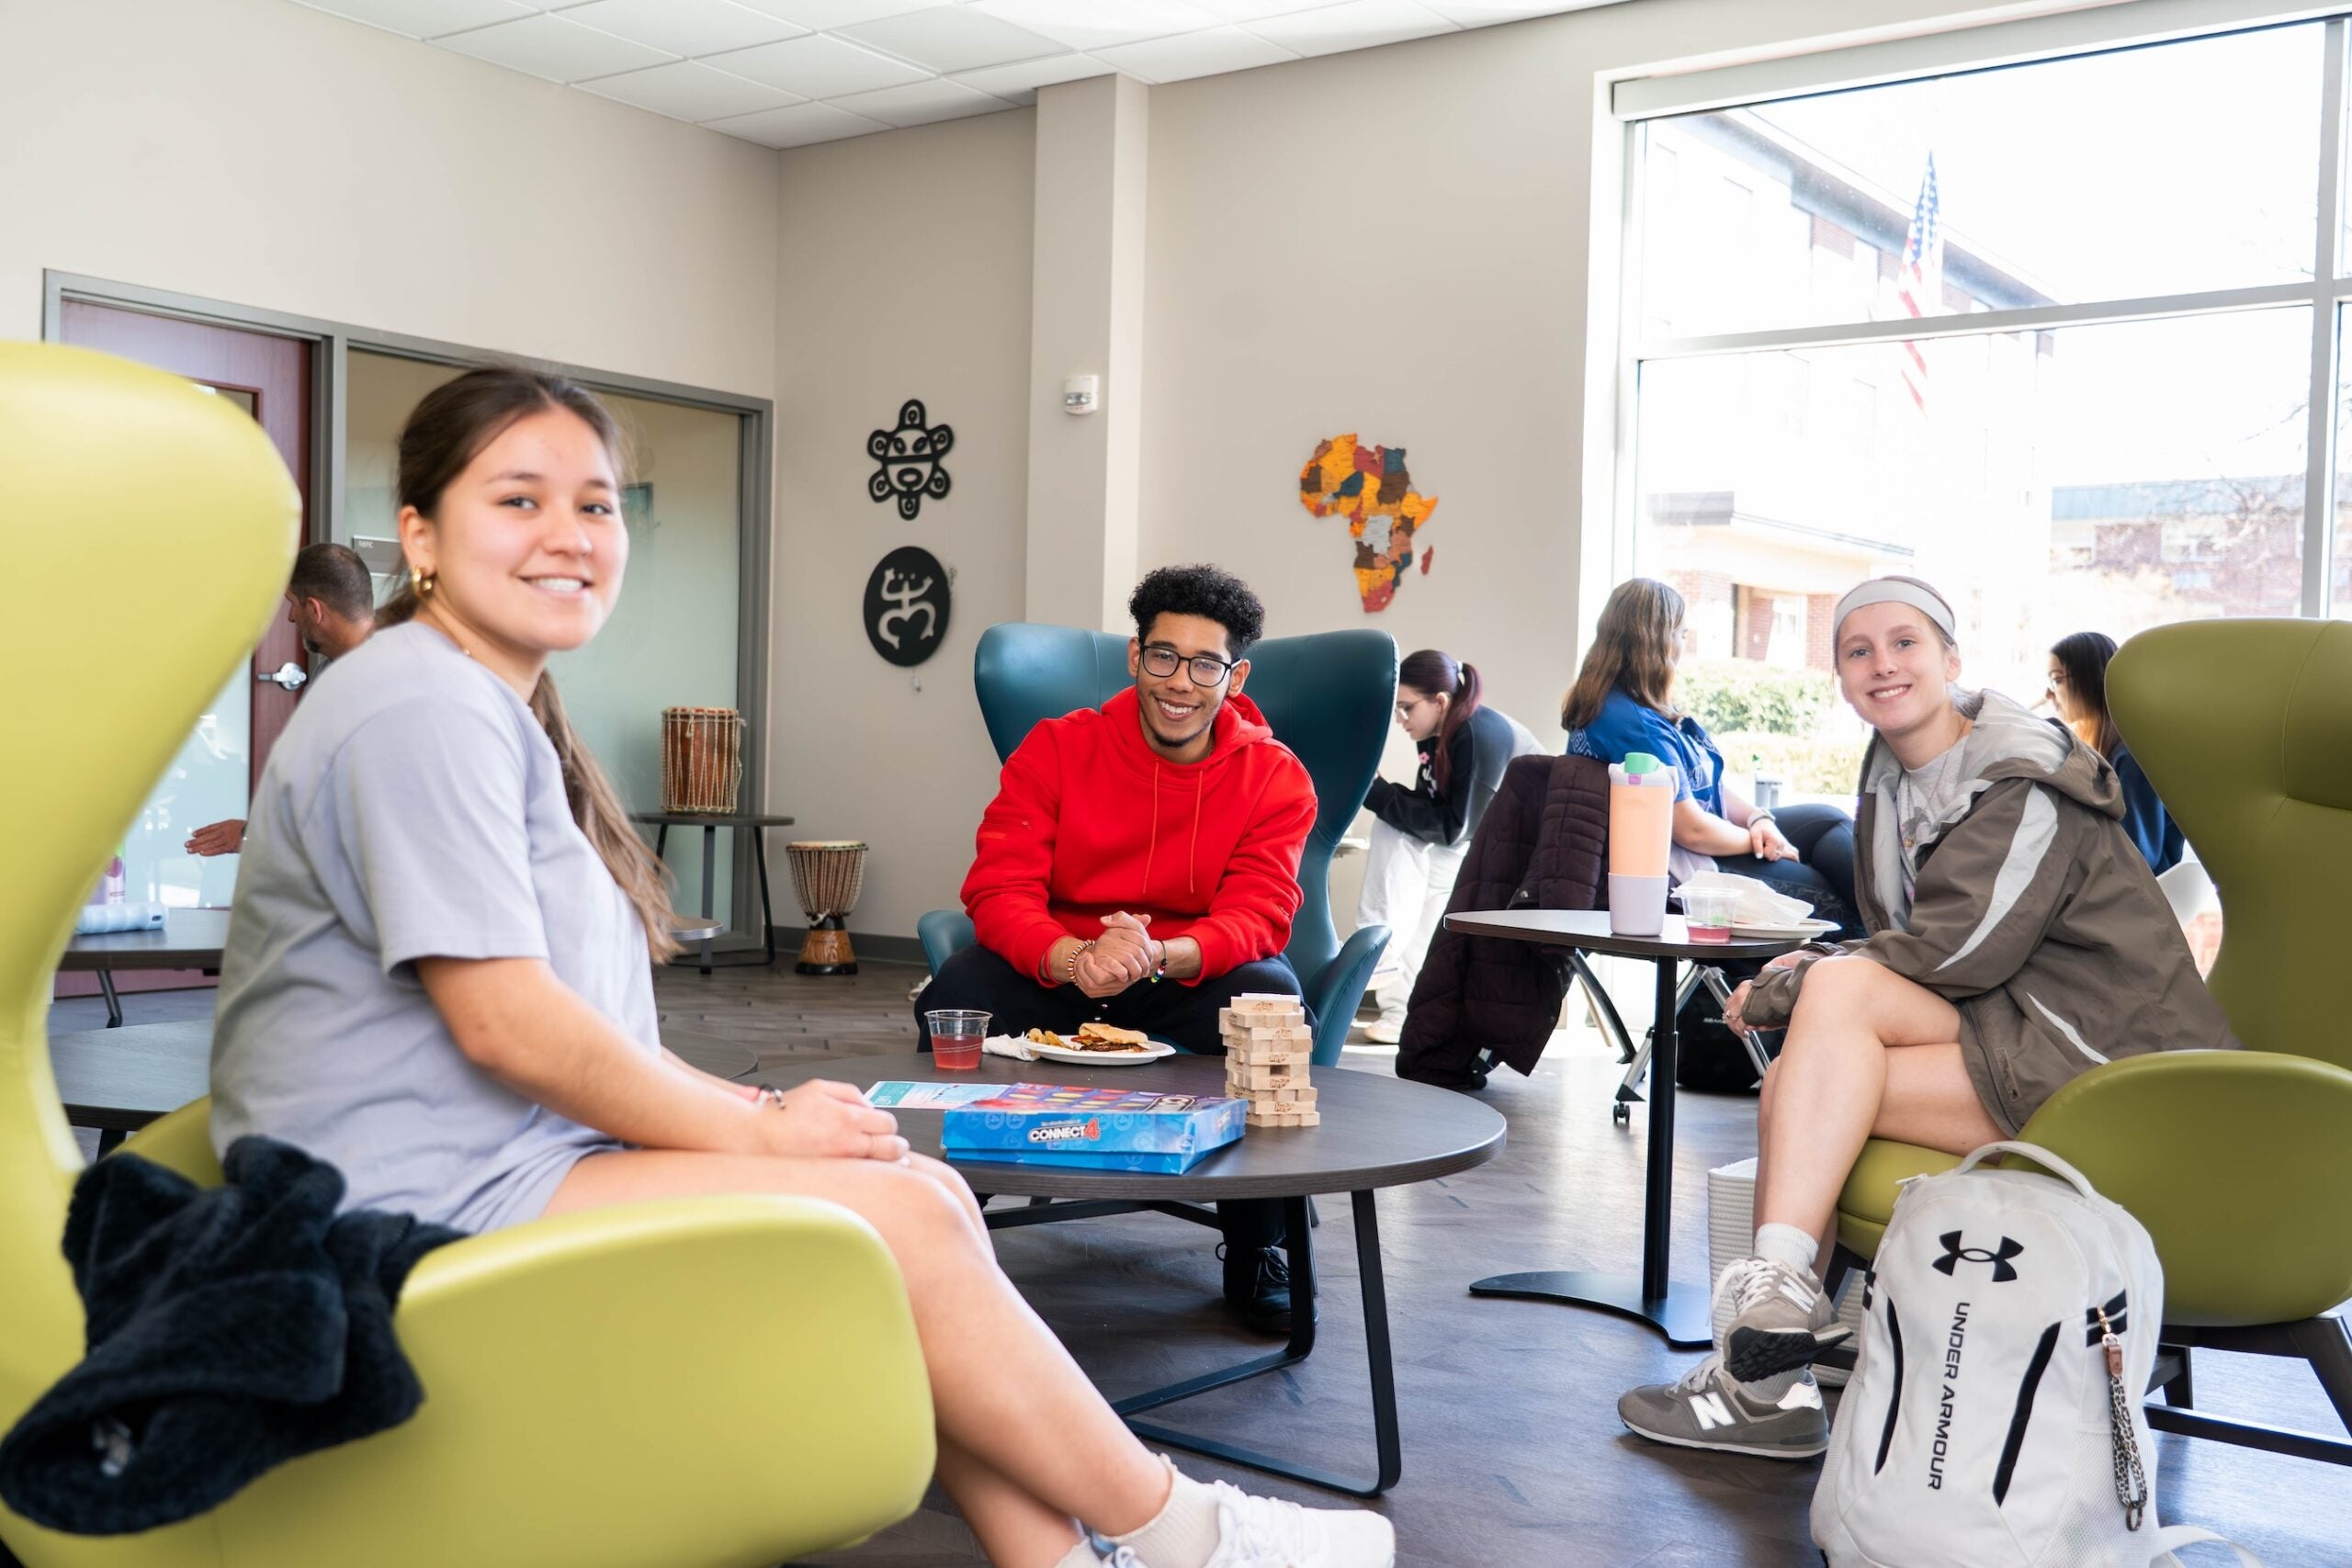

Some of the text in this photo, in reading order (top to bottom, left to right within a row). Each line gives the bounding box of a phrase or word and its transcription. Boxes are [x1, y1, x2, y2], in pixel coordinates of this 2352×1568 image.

[1688, 1391, 1736, 1430] N
[1928, 1302, 1971, 1491] UNDER ARMOUR
